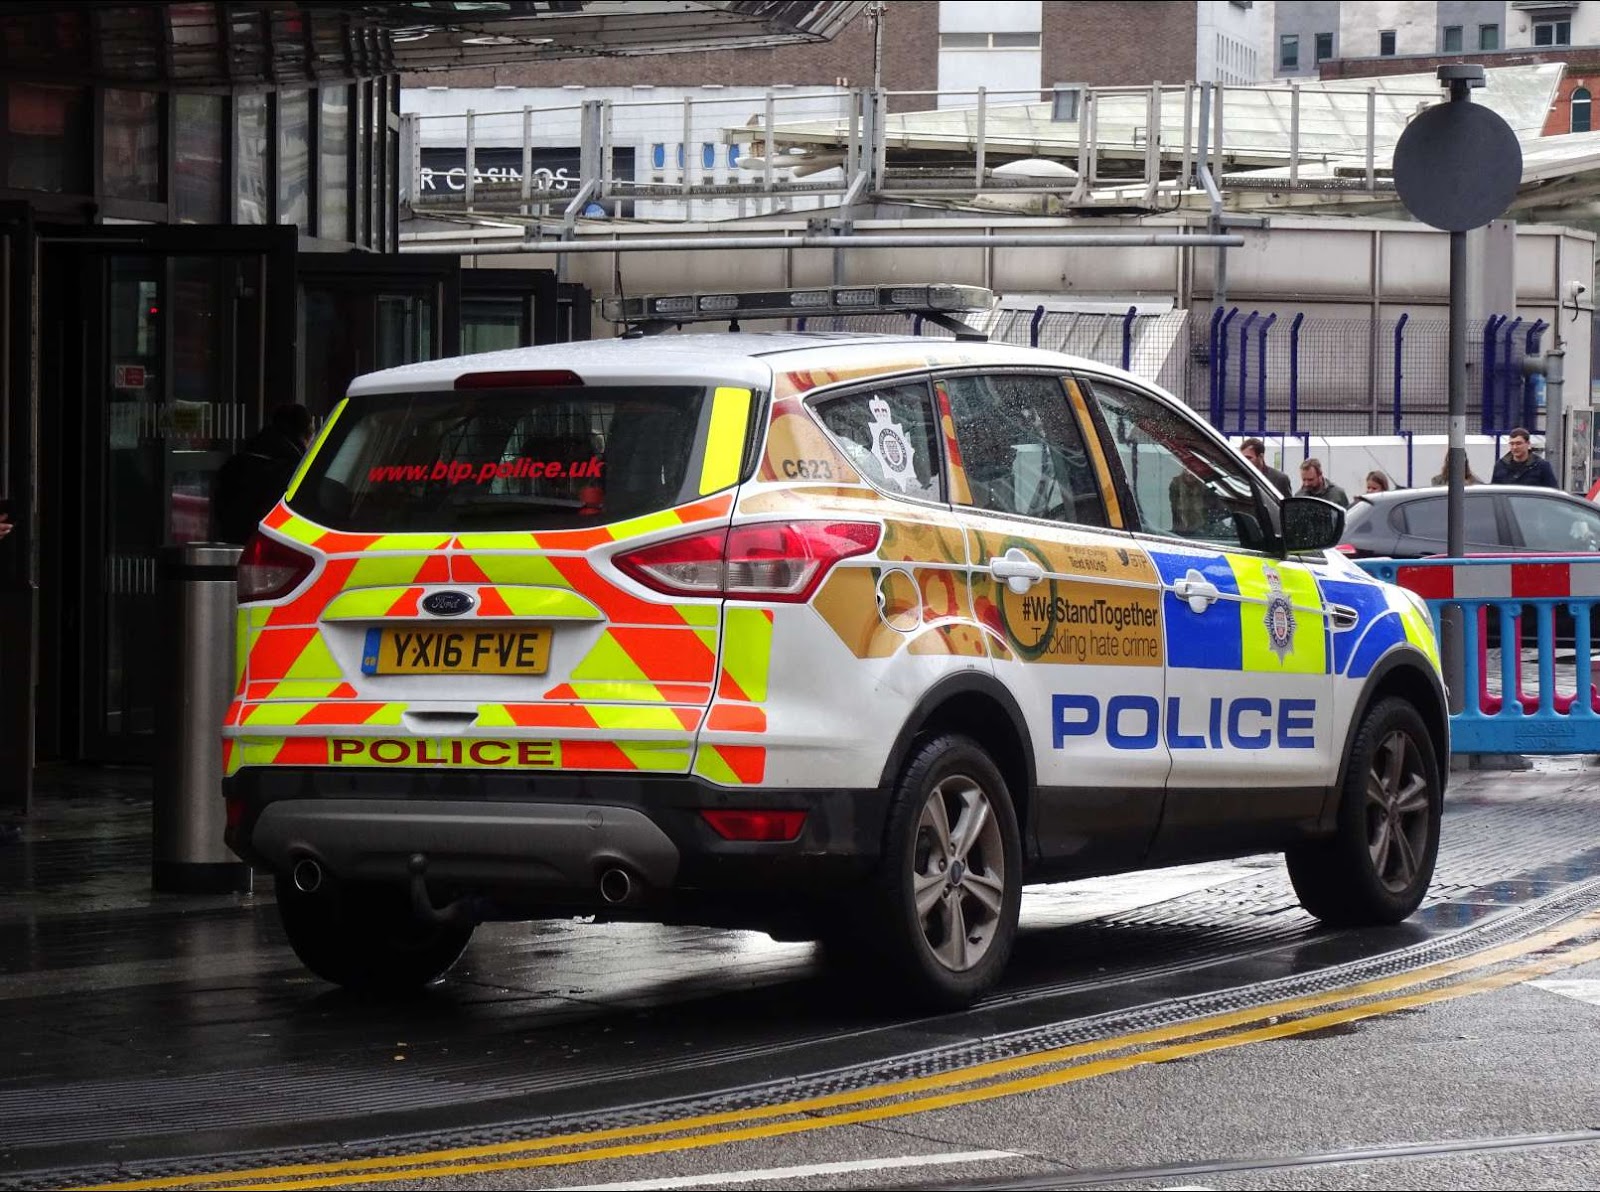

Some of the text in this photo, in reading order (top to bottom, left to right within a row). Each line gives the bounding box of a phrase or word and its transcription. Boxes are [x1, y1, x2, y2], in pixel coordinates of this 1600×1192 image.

[368, 456, 605, 485] www.btp.police.uk
[782, 459, 832, 480] C623
[431, 595, 461, 609] Ford
[1022, 596, 1158, 631] #WeStandTogether
[394, 633, 538, 667] YX16 FVE
[1031, 627, 1158, 661] Tackling hate crime
[1051, 694, 1316, 749] POLICE
[333, 739, 554, 765] POLICE
